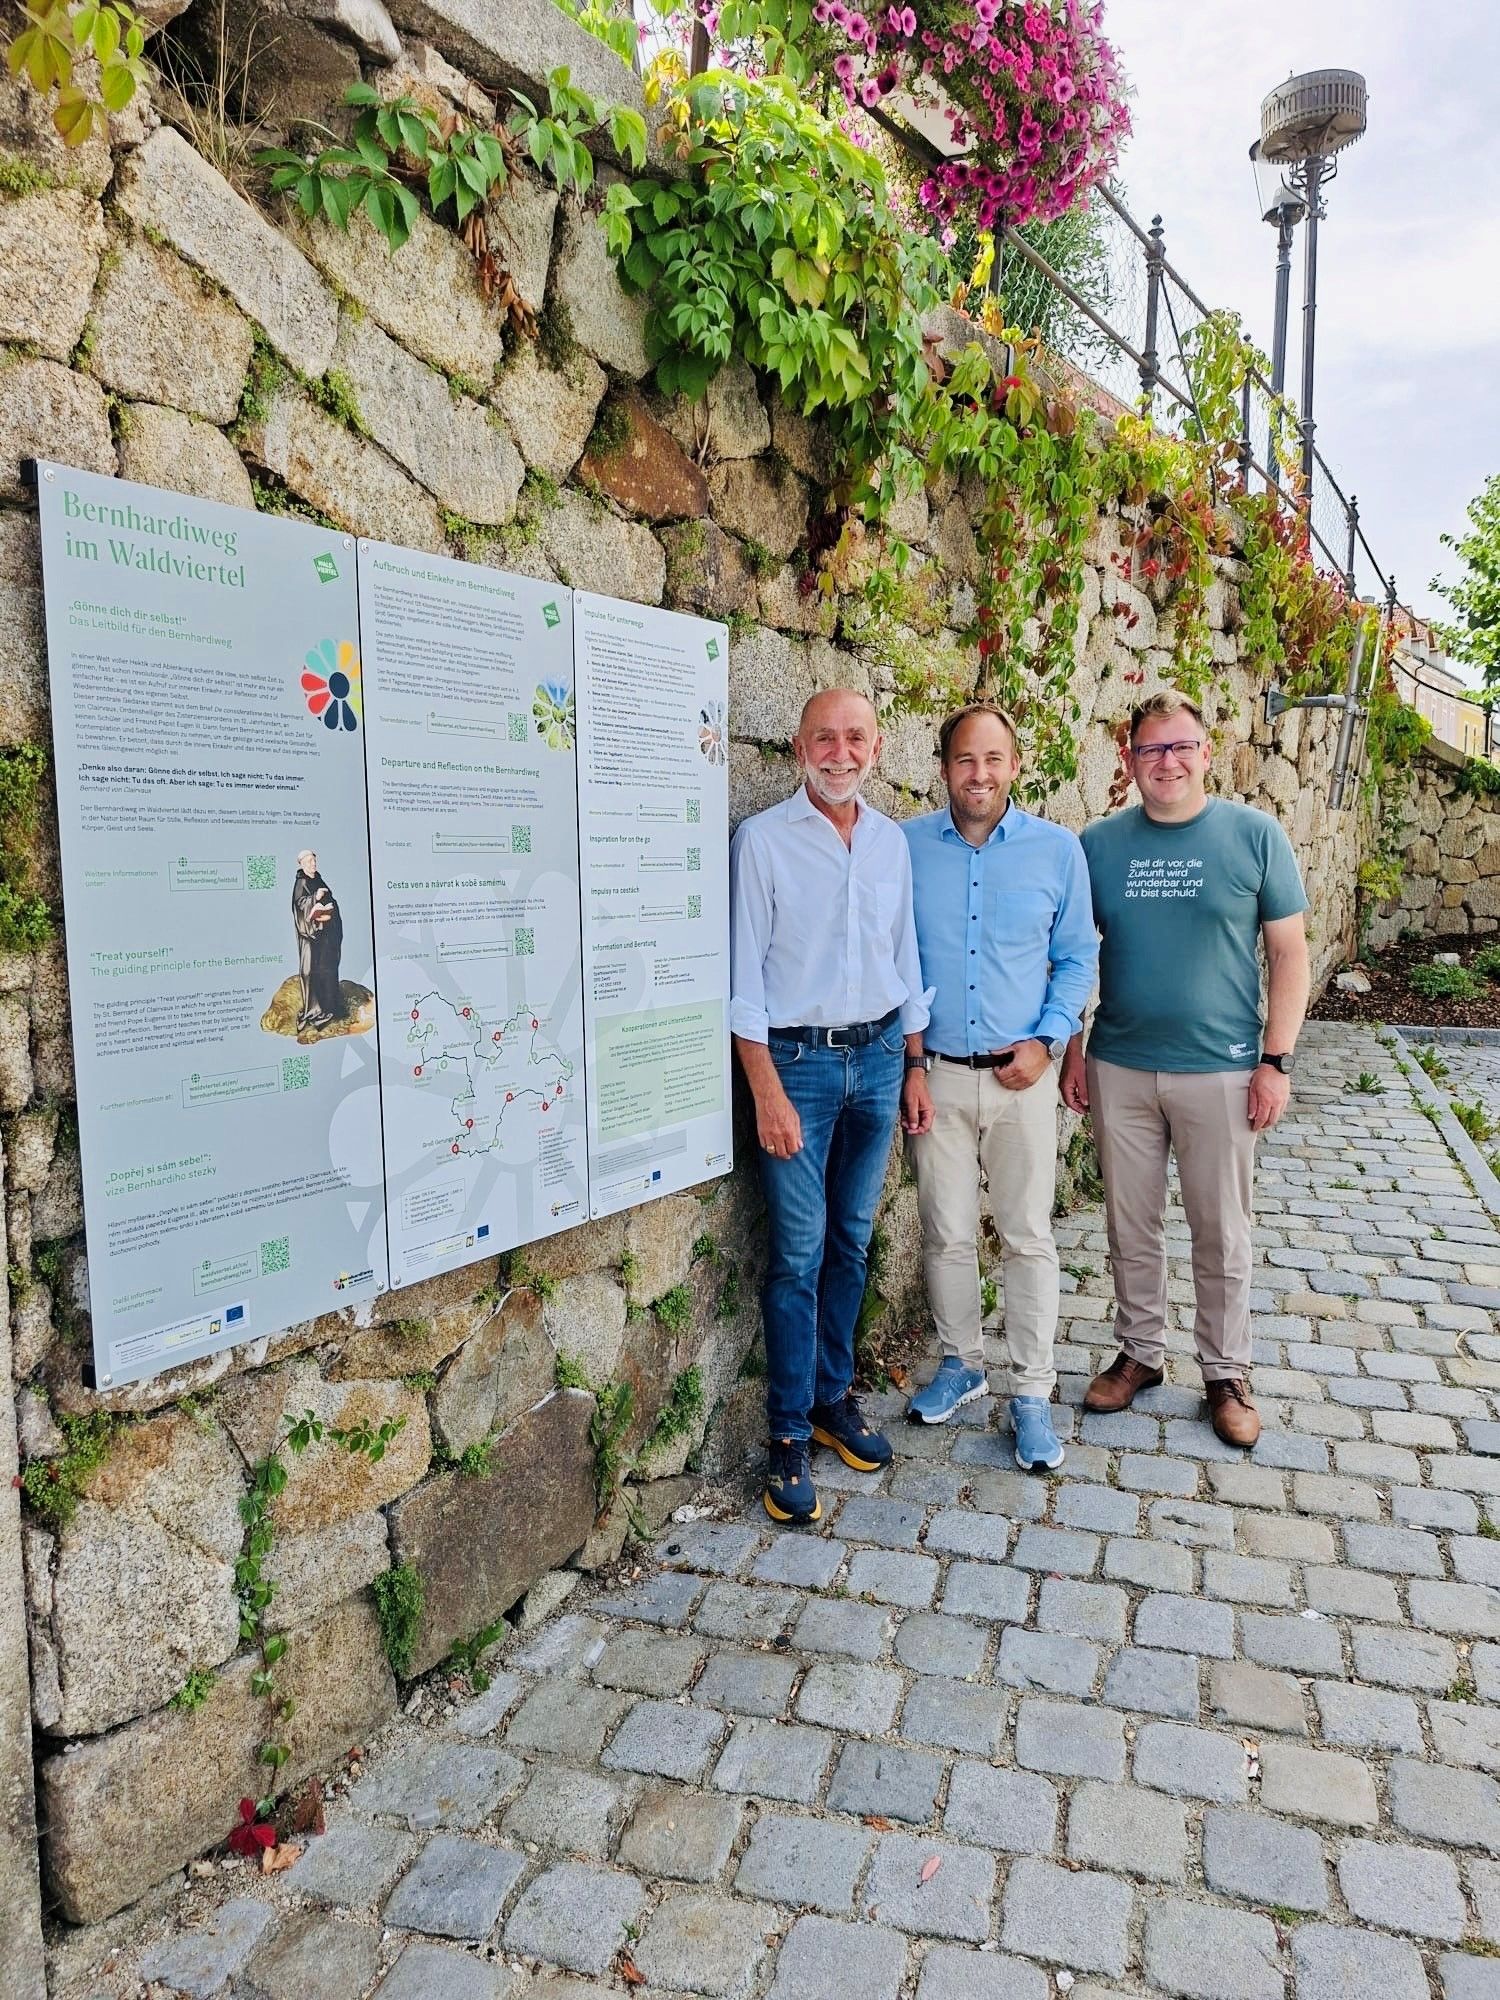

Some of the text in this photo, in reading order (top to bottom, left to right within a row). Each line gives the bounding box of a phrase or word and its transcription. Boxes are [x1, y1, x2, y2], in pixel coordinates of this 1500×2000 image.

[63, 490, 238, 556] Bernhardiweg
[65, 531, 247, 588] im Waldviertel
[373, 559, 515, 600] Aufbruch und Einkehr am Bernhardiweg
[109, 605, 131, 618] dich
[133, 608, 148, 621] dir
[584, 608, 644, 629] Impulse für unterwegs
[69, 615, 233, 649] Das Leitbild für den Bernhardiweg
[107, 765, 122, 773] also
[123, 765, 147, 774] daran:
[148, 766, 170, 775] Gönne
[171, 767, 186, 775] dich
[187, 768, 197, 776] dir
[231, 772, 246, 780] sage
[247, 771, 265, 779] nicht:
[273, 772, 284, 780] das
[381, 757, 421, 768] Departure
[422, 761, 436, 769] and
[437, 761, 472, 772] Reflection
[483, 765, 494, 774] the
[495, 765, 540, 779] Bernhardiweg
[78, 773, 90, 781] Ich
[91, 776, 109, 784] sage
[110, 775, 131, 783] nicht:
[131, 776, 141, 784] Tu
[142, 776, 155, 784] das
[156, 777, 168, 785] oft.
[169, 777, 186, 786] Aber
[186, 778, 197, 786] ich
[198, 780, 214, 788] sage:
[216, 779, 225, 787] Tu
[234, 780, 254, 789] immer
[254, 781, 276, 790] wieder
[79, 784, 110, 793] Bernhard
[80, 804, 93, 812] Der
[589, 835, 619, 844] Inspiration
[619, 835, 627, 843] for
[1130, 859, 1203, 869] Stell dir vor, die
[1128, 869, 1188, 877] Zukunft wird
[387, 880, 409, 889] Cesta
[431, 879, 454, 888] návrat
[461, 878, 478, 887] sobě
[479, 878, 506, 887] samému
[1127, 879, 1203, 888] wunderbar und
[590, 887, 612, 897] Impulsy
[619, 886, 640, 894] cestách
[1125, 889, 1199, 898] du bist schuld.
[592, 940, 657, 952] Information und Beratung
[91, 954, 283, 977] The guiding principle for the Bernhardiweg
[93, 1001, 105, 1009] The
[106, 999, 129, 1009] guiding
[129, 996, 156, 1007] principle
[112, 1007, 138, 1016] Bernard
[621, 1022, 658, 1033] Kooperationen
[659, 1018, 667, 1027] und
[147, 1164, 155, 1175] si
[157, 1160, 177, 1173] sám
[105, 1165, 217, 1198] vize Bernhardiho stezky
